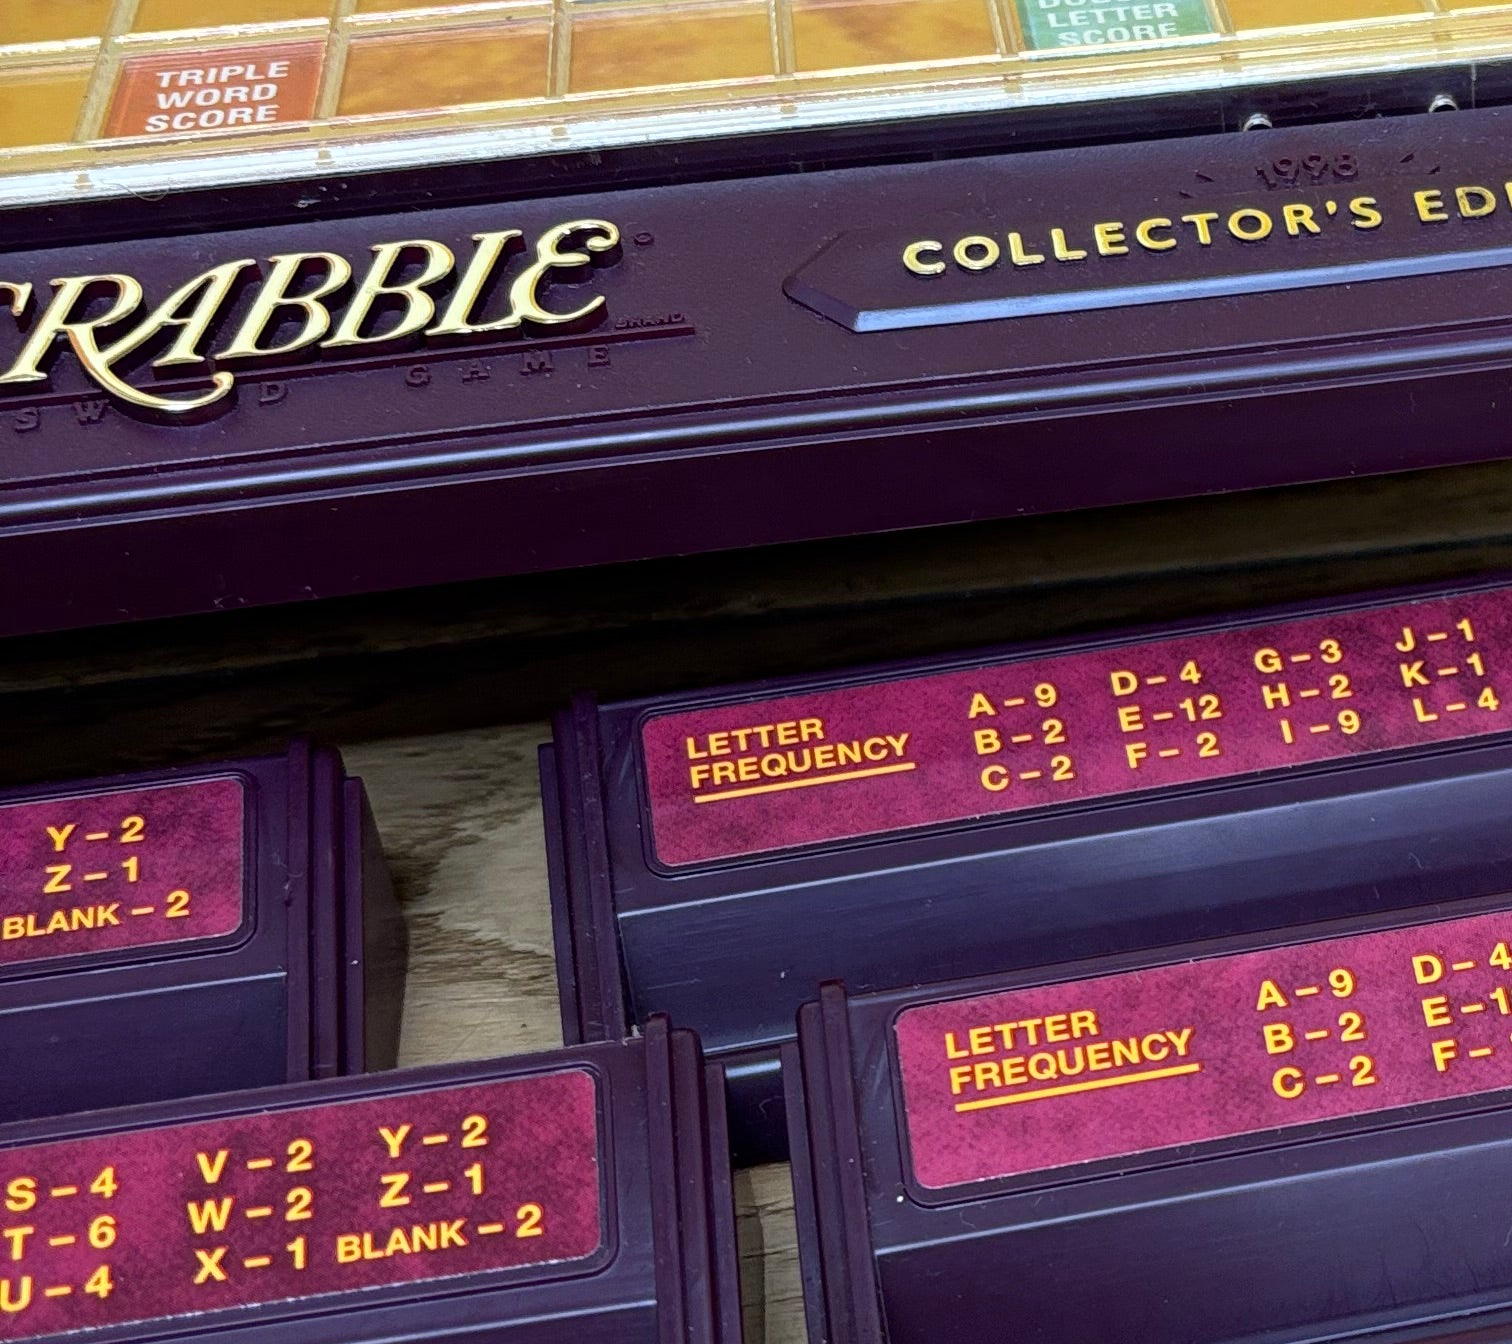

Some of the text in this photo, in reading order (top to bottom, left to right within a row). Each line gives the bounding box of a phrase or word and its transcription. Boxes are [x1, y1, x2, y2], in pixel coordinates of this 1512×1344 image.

[1047, 2, 1180, 29] LETTER
[1057, 22, 1181, 48] SCORE
[156, 60, 291, 88] TRIPLE
[156, 83, 279, 110] WORD
[144, 104, 281, 133] SCORE
[903, 196, 1382, 274] COLLECTOR'S
[686, 718, 824, 760] LETTER
[690, 733, 909, 789] FREQUENCY
[944, 1010, 1099, 1060] LETTER
[949, 1028, 1192, 1096] FREQUENCY
